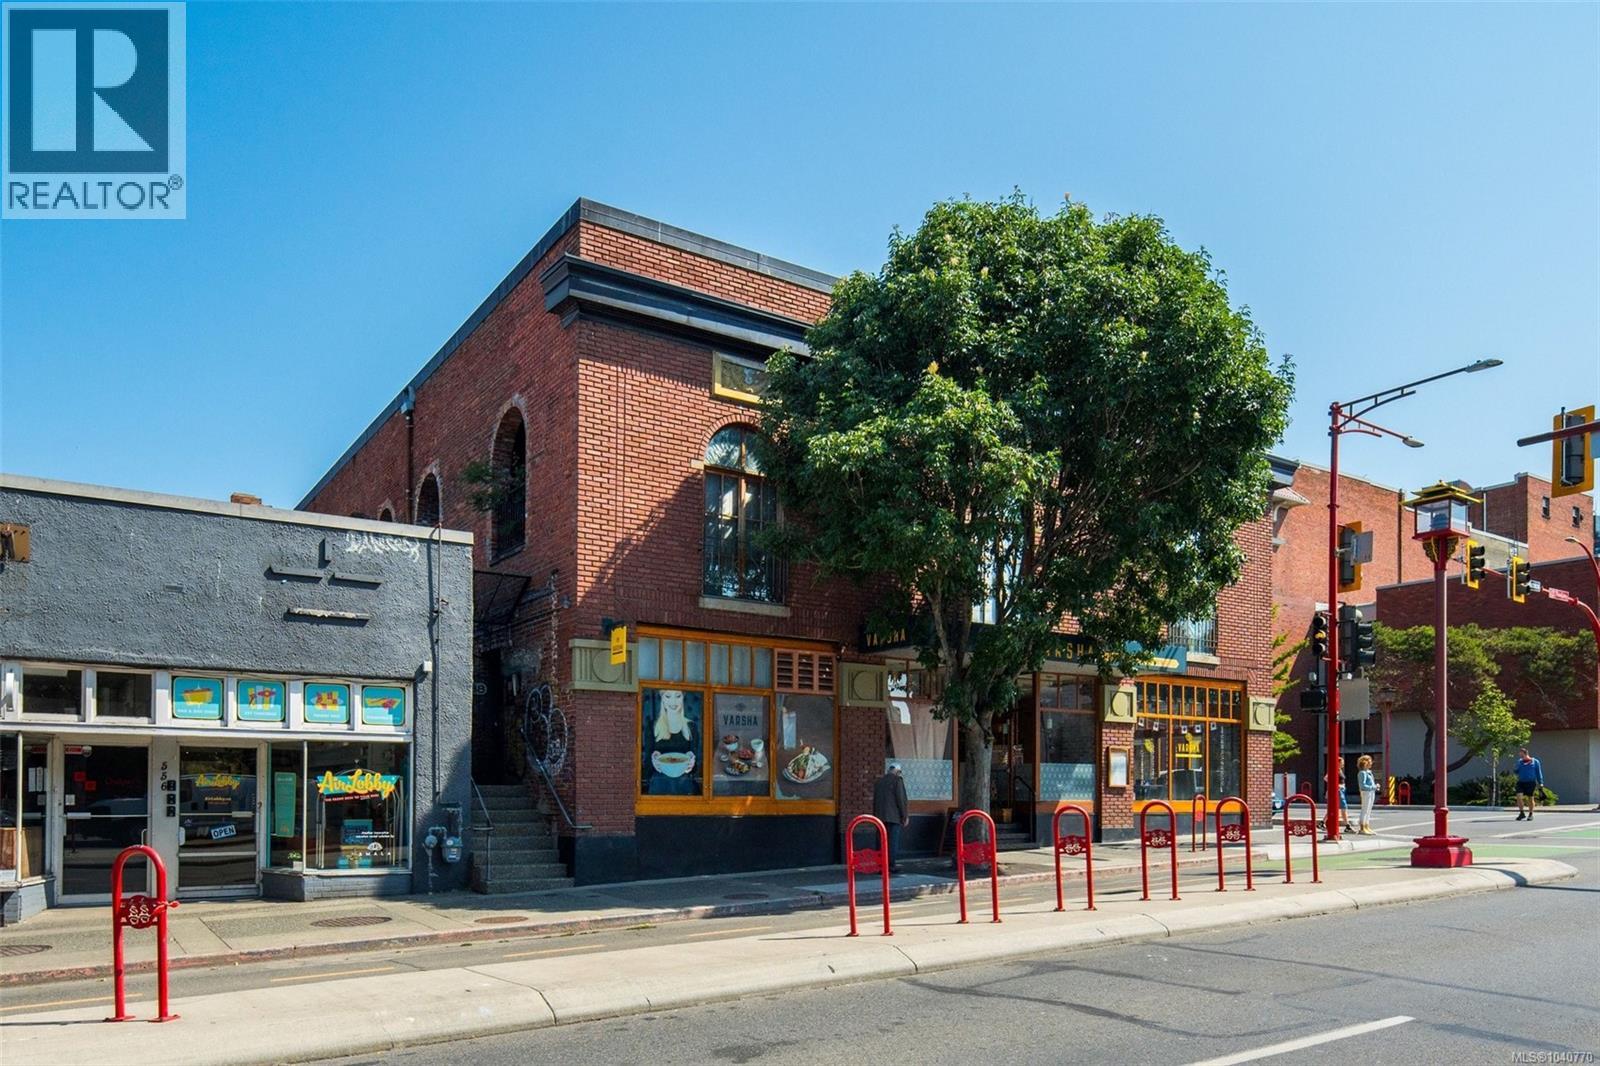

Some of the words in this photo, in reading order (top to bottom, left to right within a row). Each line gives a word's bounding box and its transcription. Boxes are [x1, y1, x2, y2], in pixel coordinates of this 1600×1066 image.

[723, 714, 759, 727] VARSHA
[317, 768, 396, 800] AirLobby
[213, 825, 236, 838] OPEN
